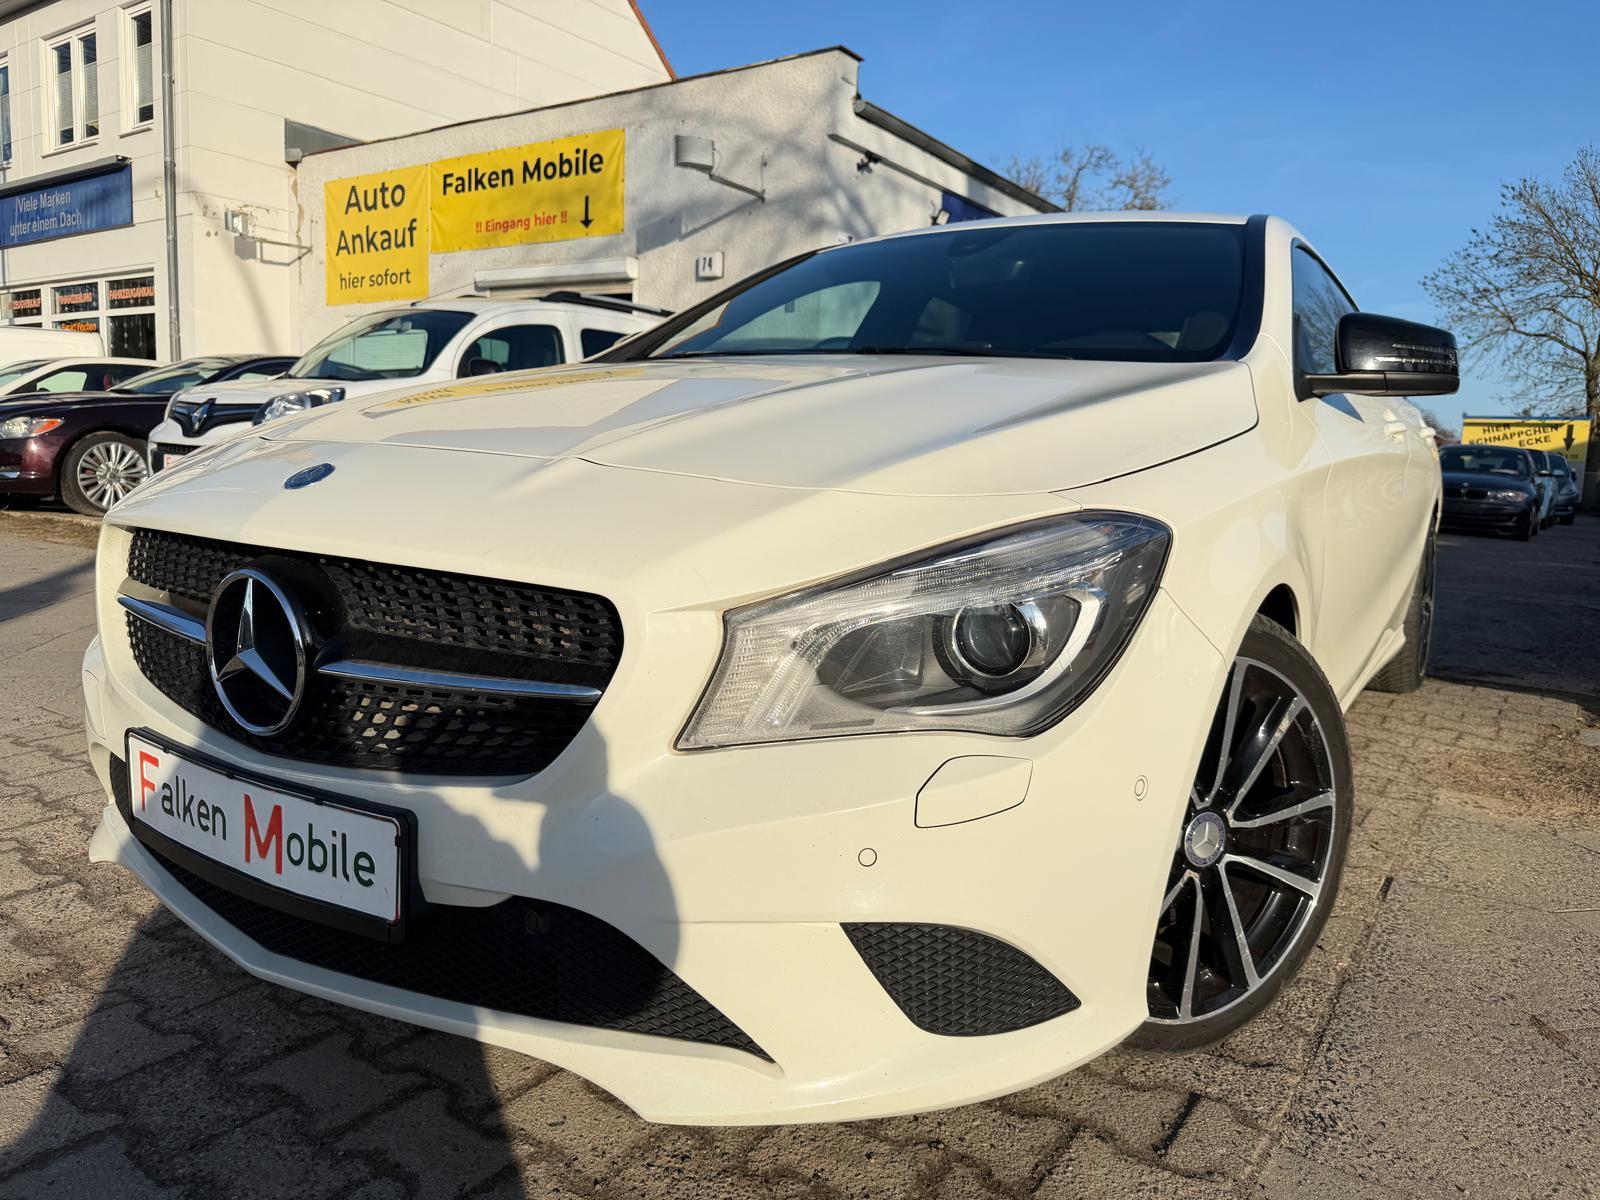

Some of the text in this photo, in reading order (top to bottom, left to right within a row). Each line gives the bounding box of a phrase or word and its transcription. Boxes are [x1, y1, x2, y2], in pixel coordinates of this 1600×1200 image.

[442, 147, 604, 196] Falken Mobile
[17, 191, 71, 213] Viele Marken
[344, 181, 406, 215] Auto
[9, 208, 82, 237] unter einem Dach
[475, 211, 568, 233] !! Eingang hier !!
[335, 218, 417, 257] Ankauf
[702, 257, 713, 271] 74
[339, 268, 411, 290] hier sofort
[1482, 425, 1511, 434] HIER
[1518, 435, 1551, 447] ECKE
[139, 750, 376, 887] Falken Mobile
